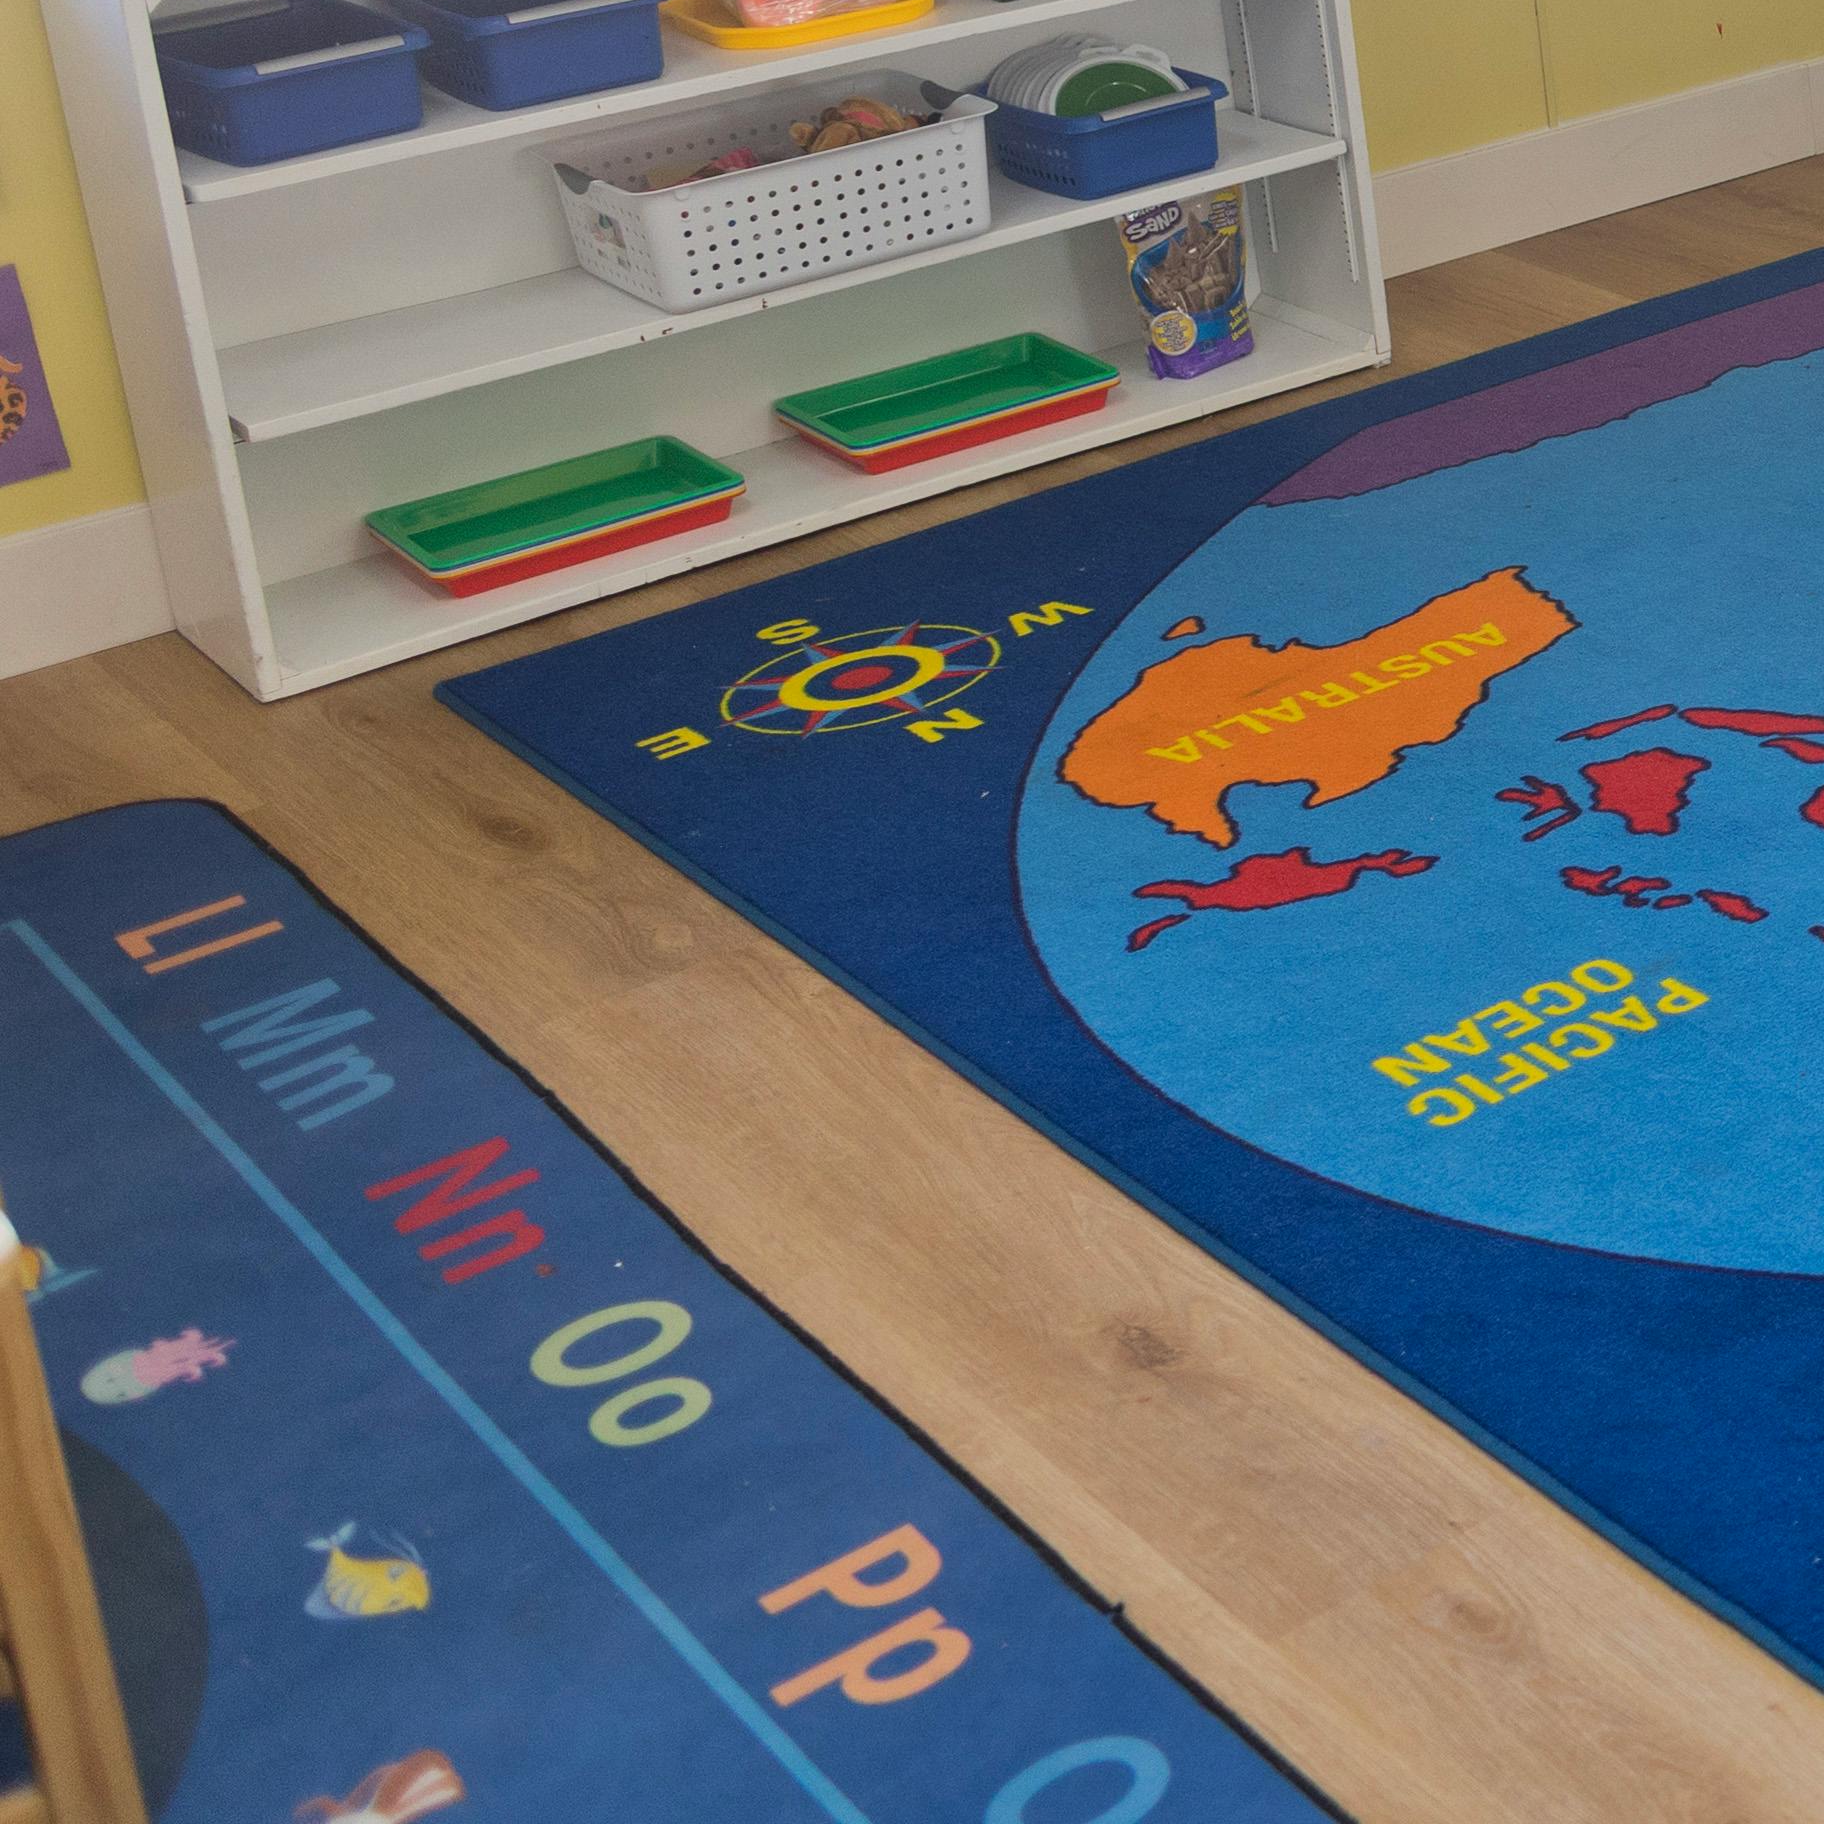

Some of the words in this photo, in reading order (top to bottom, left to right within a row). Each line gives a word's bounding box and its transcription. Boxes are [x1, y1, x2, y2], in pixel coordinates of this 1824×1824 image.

[756, 618, 820, 645] S
[1010, 600, 1095, 637] W
[1146, 604, 1508, 766] AUSTRALIA
[635, 727, 713, 760] E
[904, 707, 985, 743] N
[115, 894, 285, 975] Ll
[201, 977, 396, 1132] Mm
[1371, 959, 1635, 1087] OCEAN
[1407, 977, 1710, 1126] PACIFIC
[364, 1136, 545, 1285] Nn
[530, 1300, 713, 1447] Oo
[757, 1523, 972, 1707] Pp
